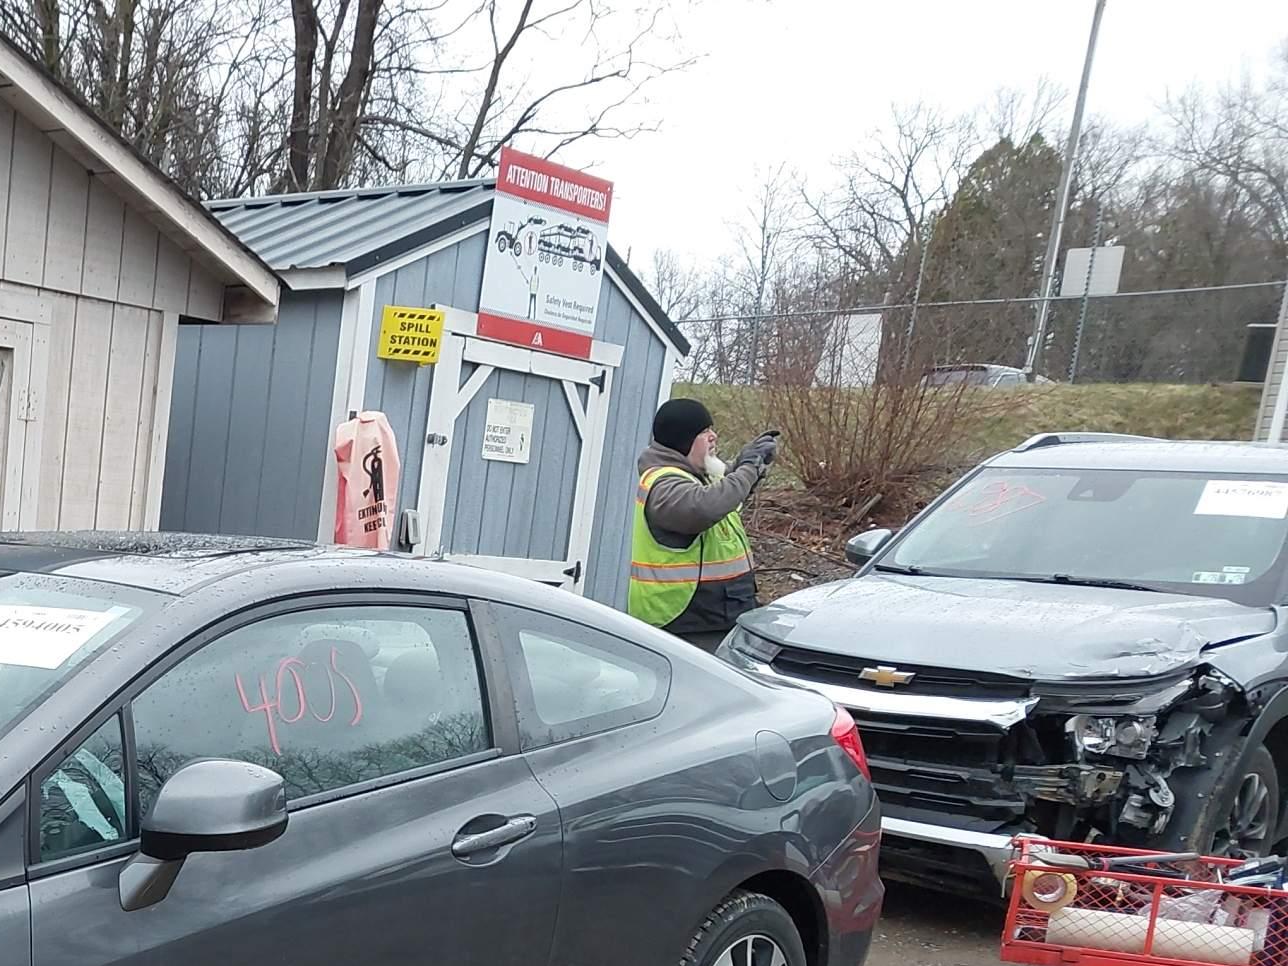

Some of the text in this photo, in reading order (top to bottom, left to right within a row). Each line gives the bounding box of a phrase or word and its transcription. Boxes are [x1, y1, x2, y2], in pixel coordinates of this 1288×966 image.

[506, 164, 607, 211] ATTENTION TRANSPORTERS!
[545, 294, 594, 314] Safety Vest Required
[400, 321, 431, 334] SPILL
[390, 335, 437, 348] STATION
